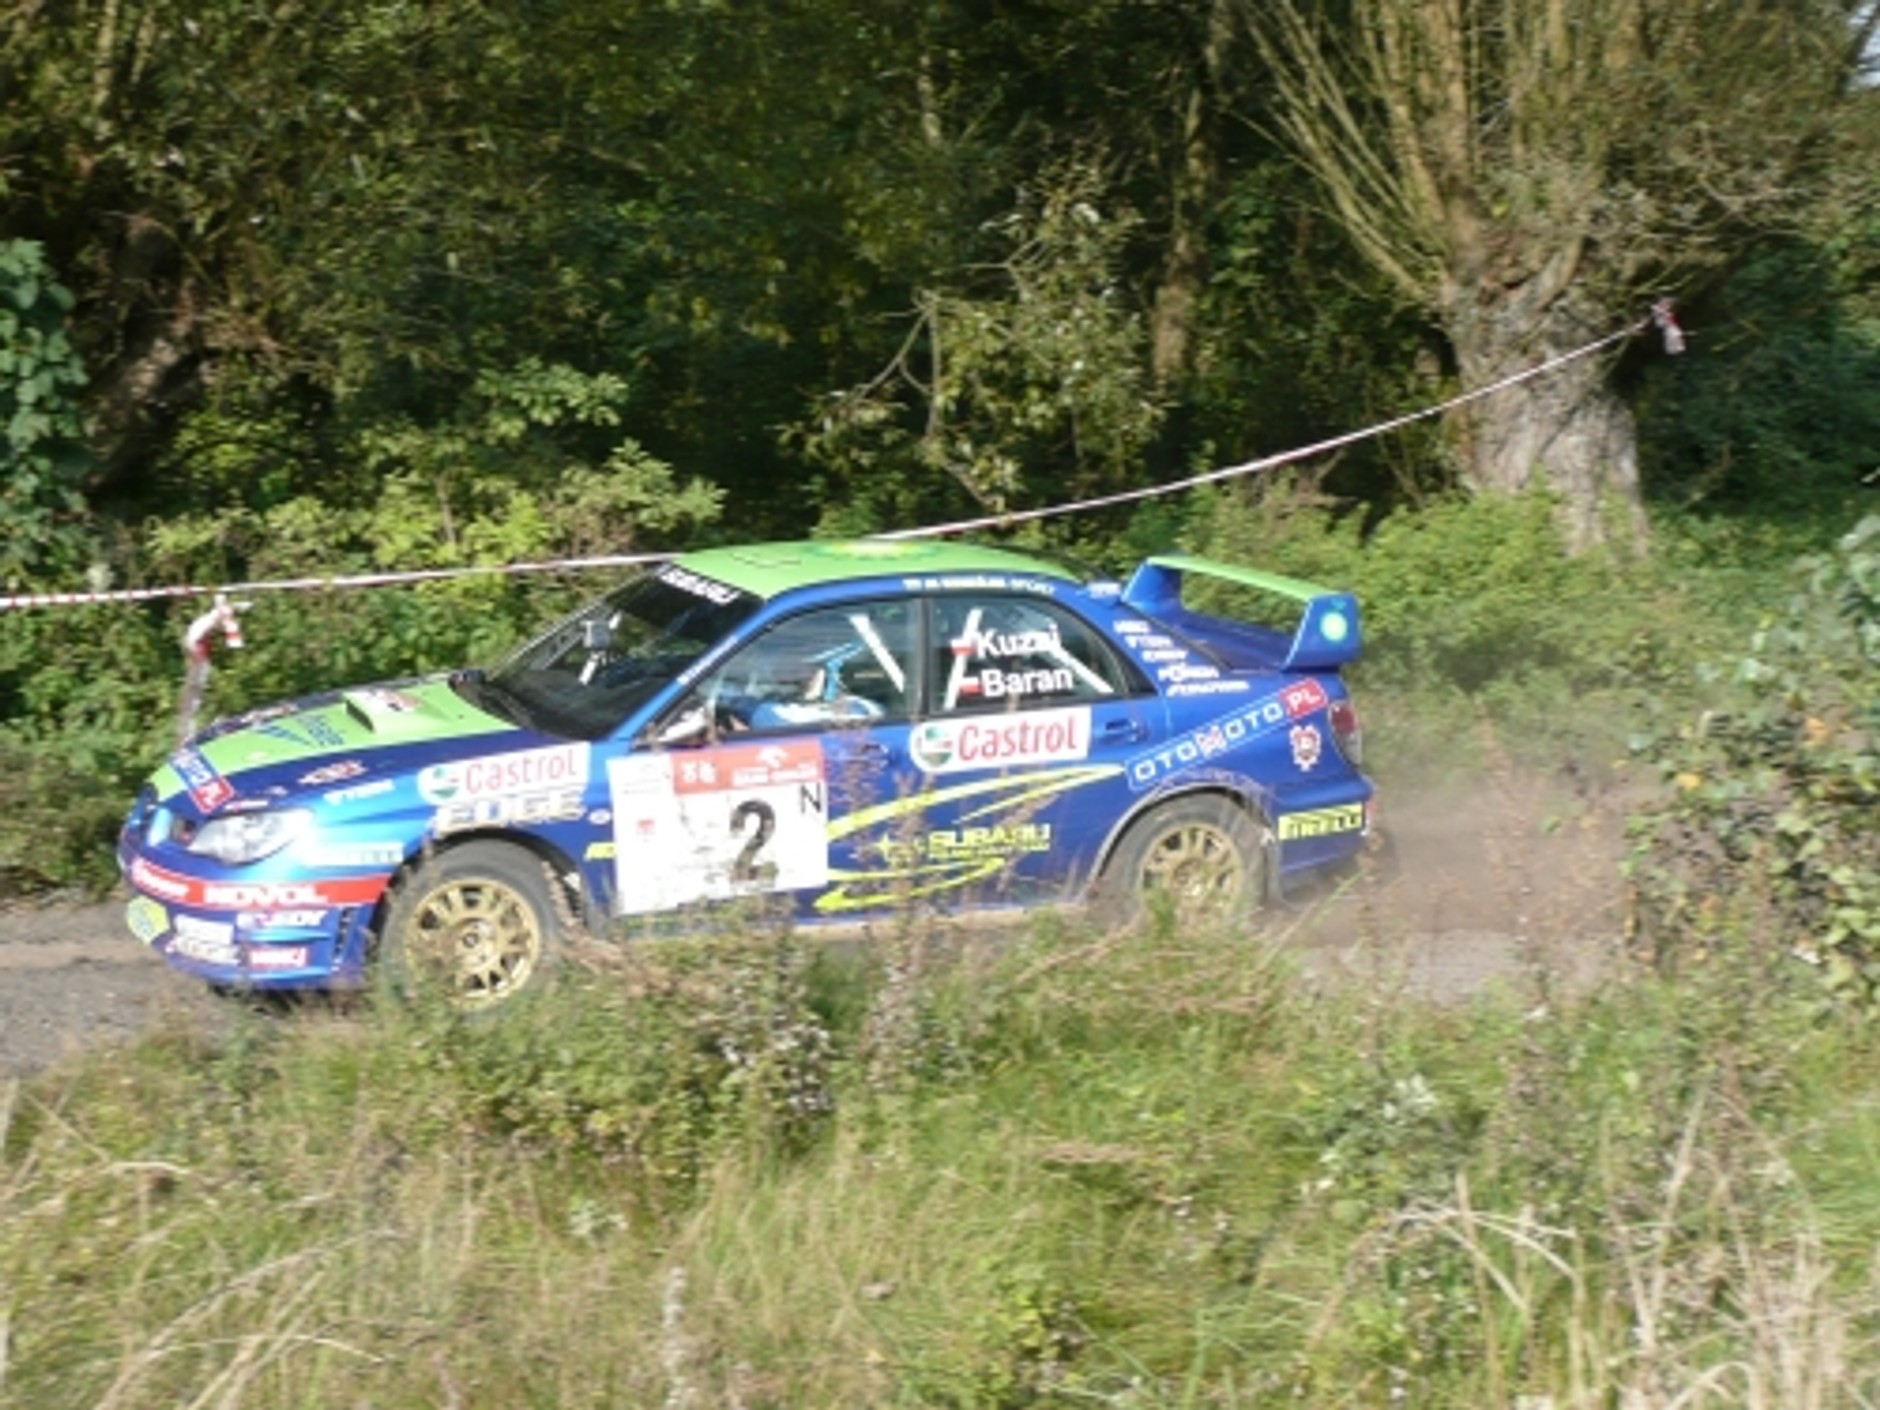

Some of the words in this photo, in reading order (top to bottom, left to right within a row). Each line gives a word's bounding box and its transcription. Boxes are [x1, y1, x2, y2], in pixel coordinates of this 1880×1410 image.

[980, 666, 1073, 697] Baran
[957, 714, 1078, 763] Castrol
[466, 748, 577, 795] Castrol
[800, 781, 823, 815] N
[729, 798, 779, 884] 2
[204, 884, 328, 905] NOVOL
